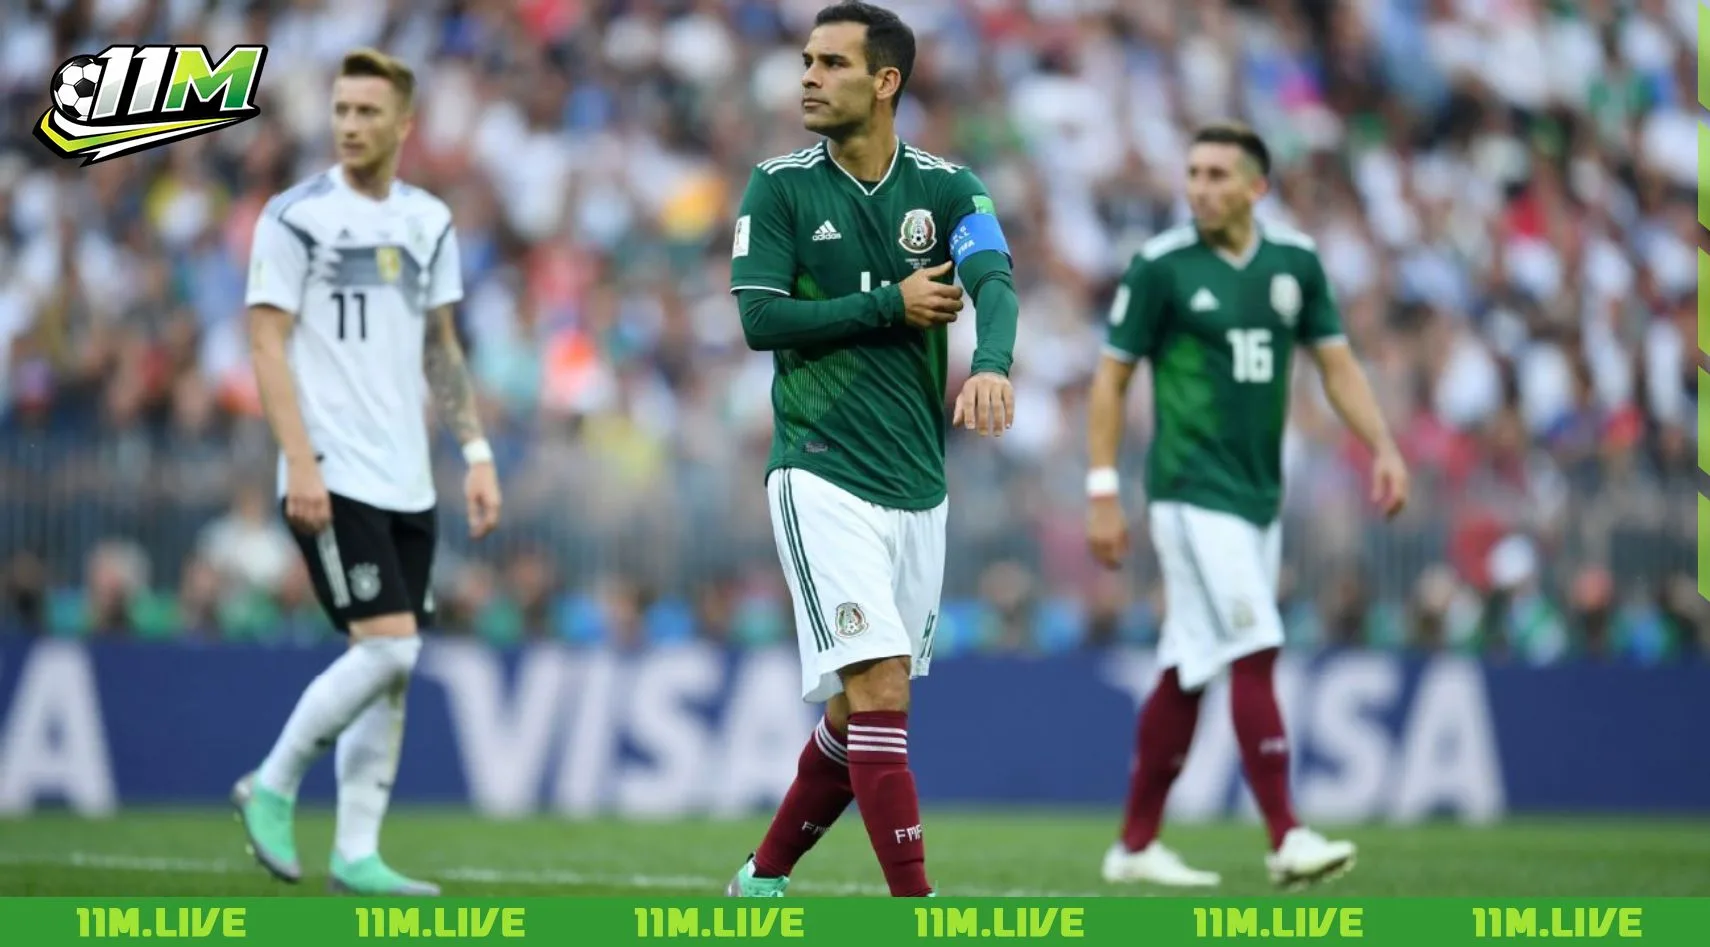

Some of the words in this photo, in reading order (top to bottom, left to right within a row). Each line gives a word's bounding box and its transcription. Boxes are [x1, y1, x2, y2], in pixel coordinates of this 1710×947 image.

[330, 292, 367, 340] 11
[1226, 328, 1275, 383] 16
[425, 638, 812, 820] VISA
